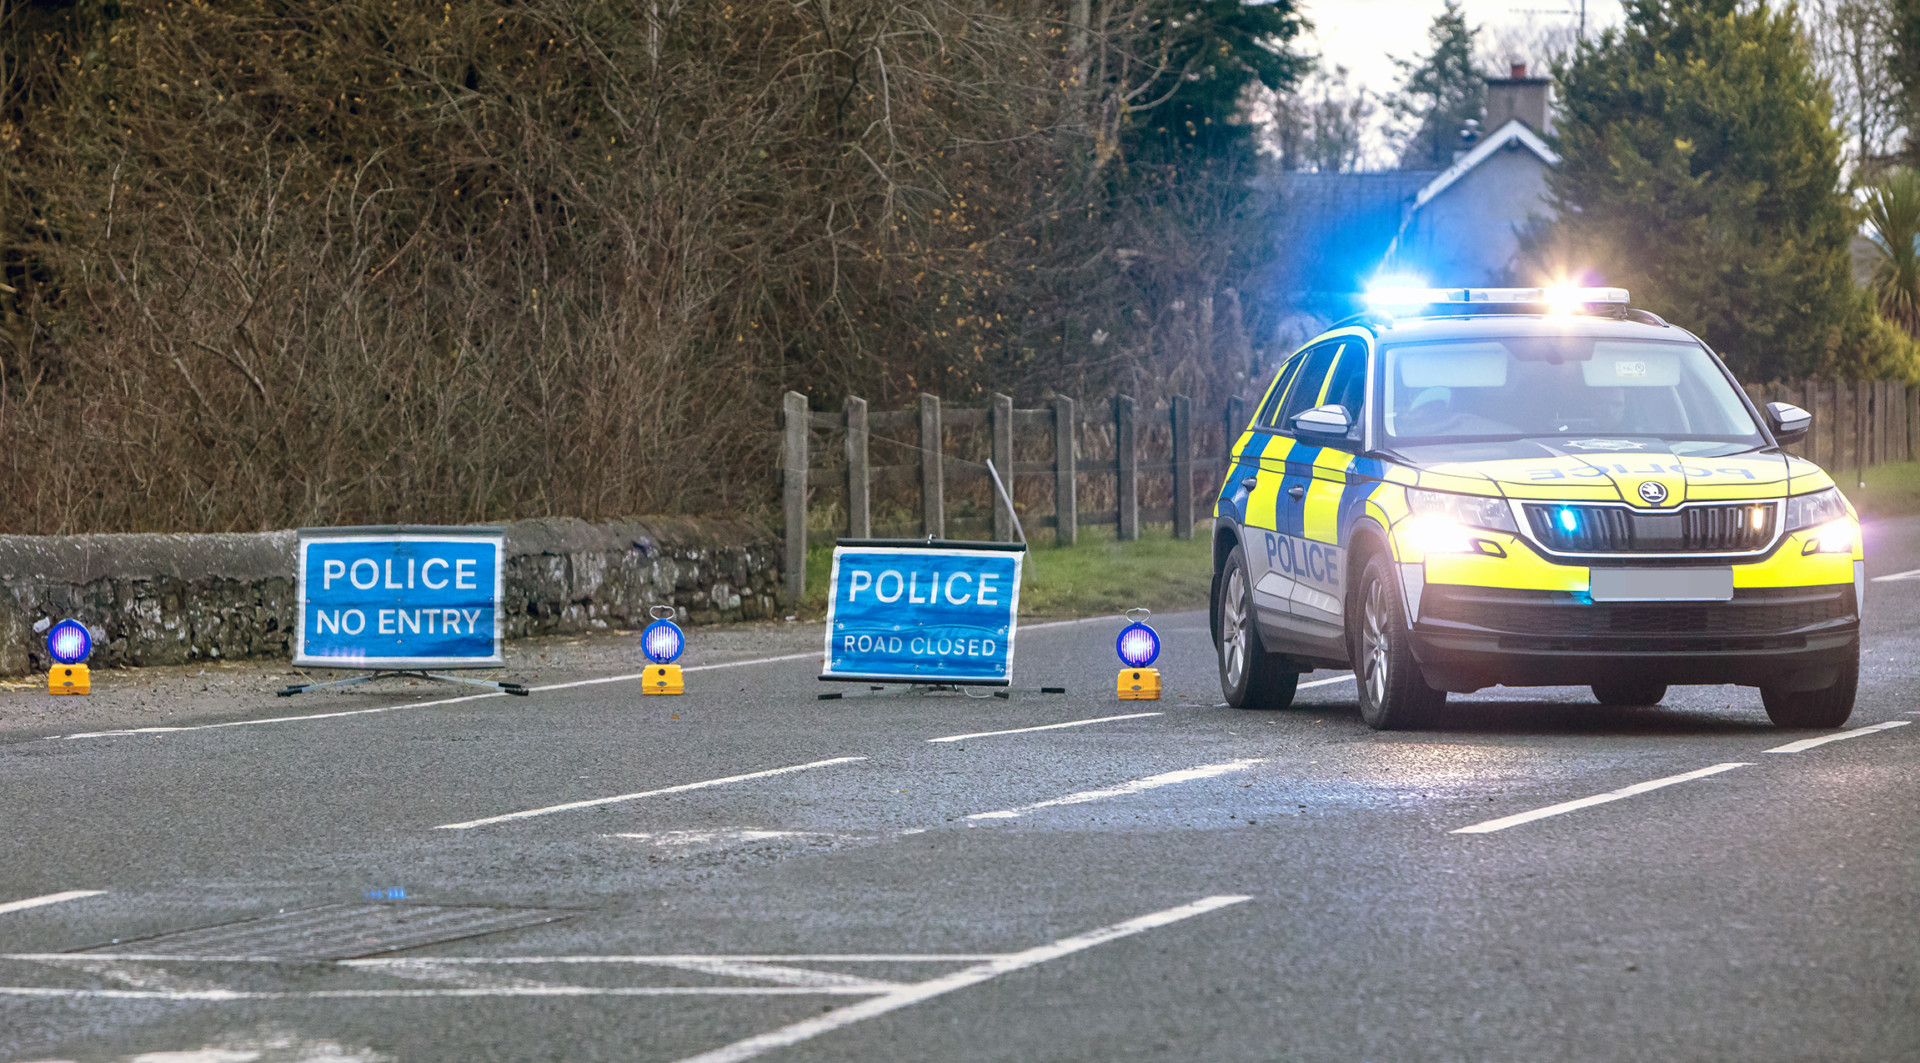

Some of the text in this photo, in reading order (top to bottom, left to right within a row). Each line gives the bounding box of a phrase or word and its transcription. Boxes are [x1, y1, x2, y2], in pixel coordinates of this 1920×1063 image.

[323, 557, 477, 590] POLICE
[1264, 532, 1340, 586] POLICE
[849, 569, 1000, 606] POLICE
[316, 608, 482, 635] NO ENTRY
[844, 635, 996, 657] ROAD CLOSED
